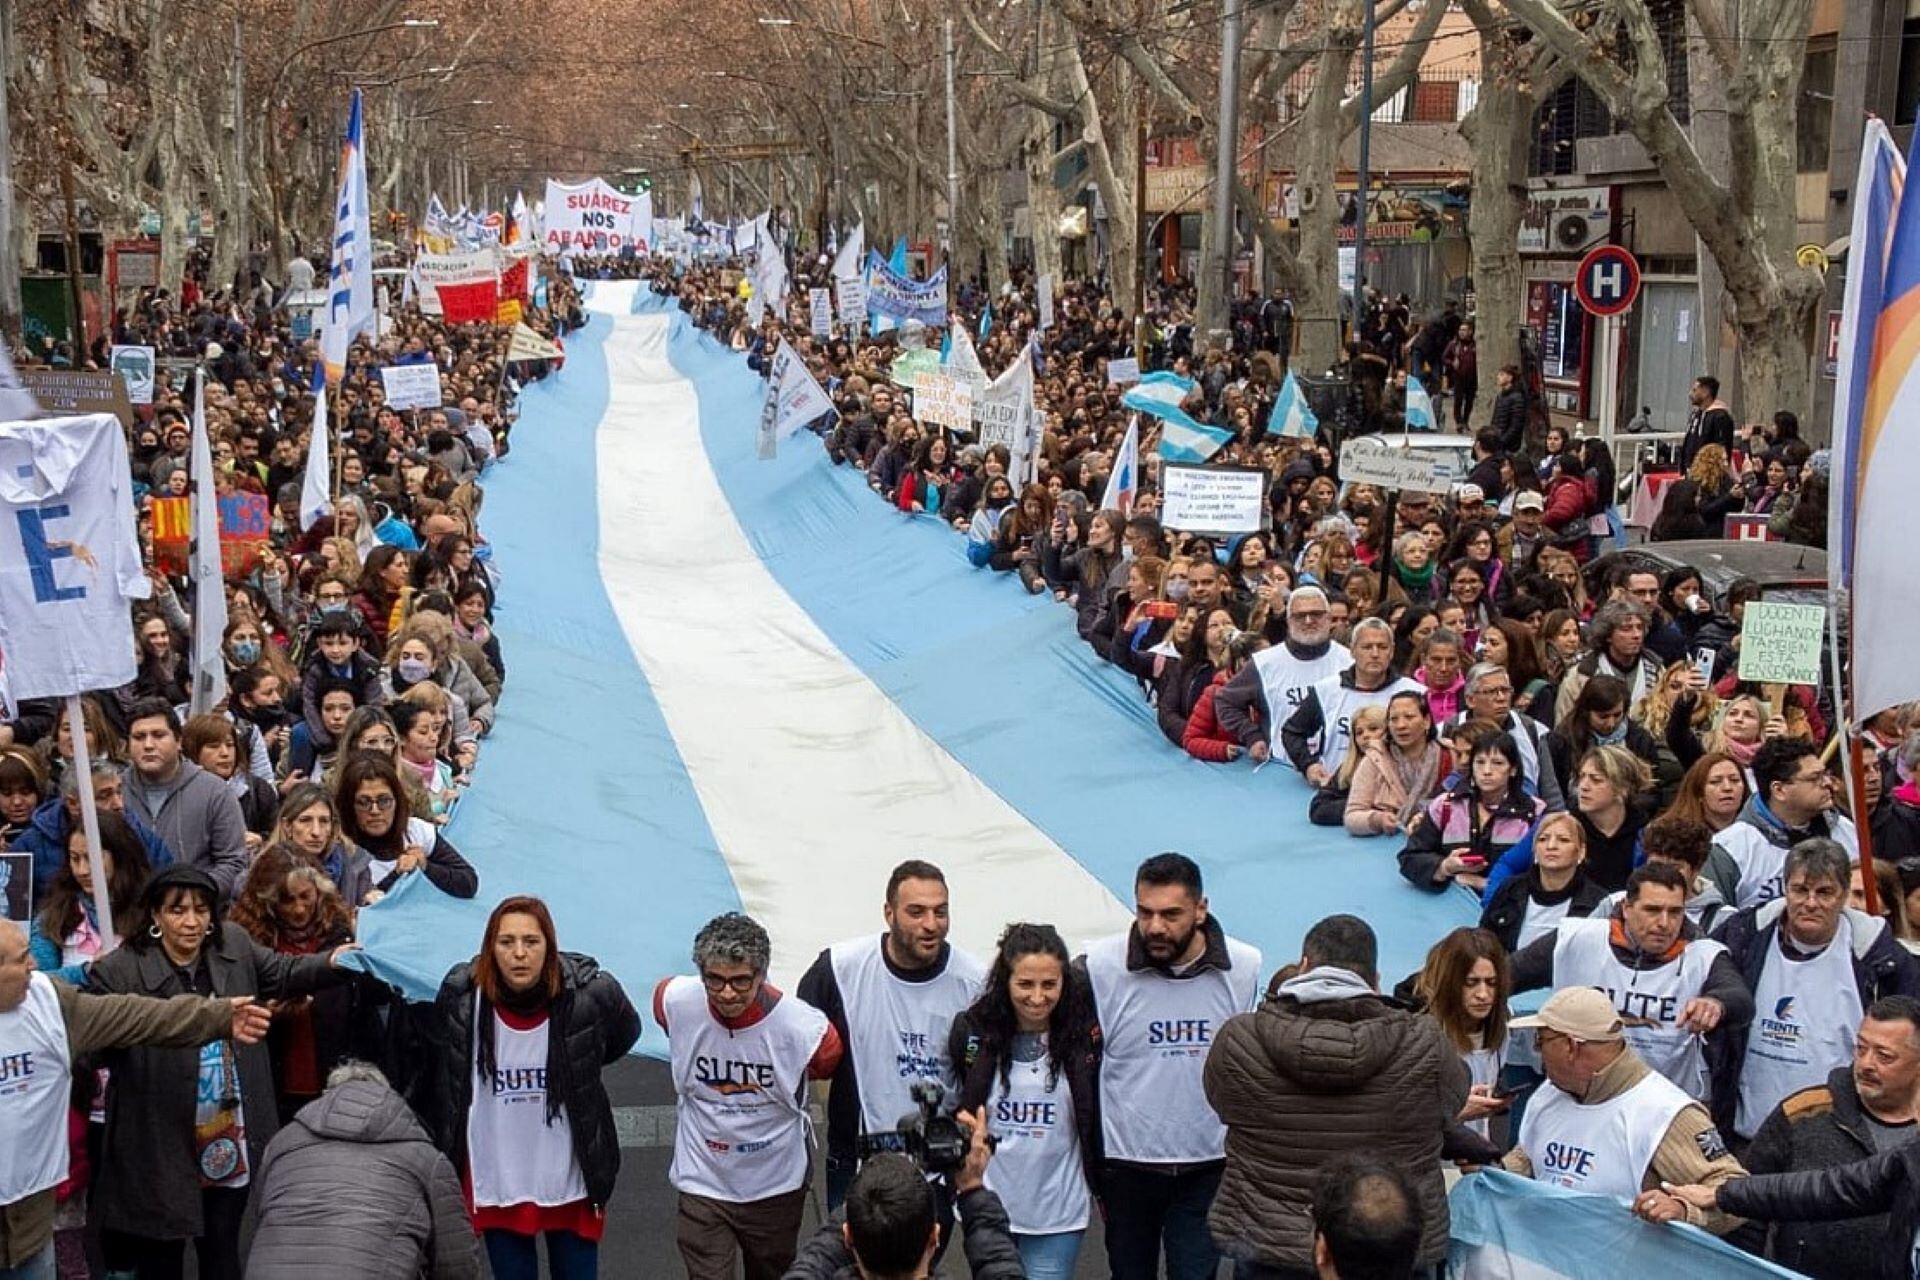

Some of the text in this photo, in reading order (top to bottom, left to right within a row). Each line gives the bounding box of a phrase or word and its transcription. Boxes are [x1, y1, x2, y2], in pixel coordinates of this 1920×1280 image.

[567, 187, 631, 214] SUÁREZ
[582, 211, 615, 229] NOS
[1592, 263, 1622, 299] H
[1759, 606, 1821, 621] DOCENTE
[1745, 621, 1822, 641] LUCHANDO
[1592, 986, 1677, 1022] UTE
[1149, 1020, 1210, 1044] SUTE
[695, 1056, 775, 1088] SUTE
[997, 1101, 1056, 1125] SUTE
[1544, 1142, 1595, 1177] SUTE
